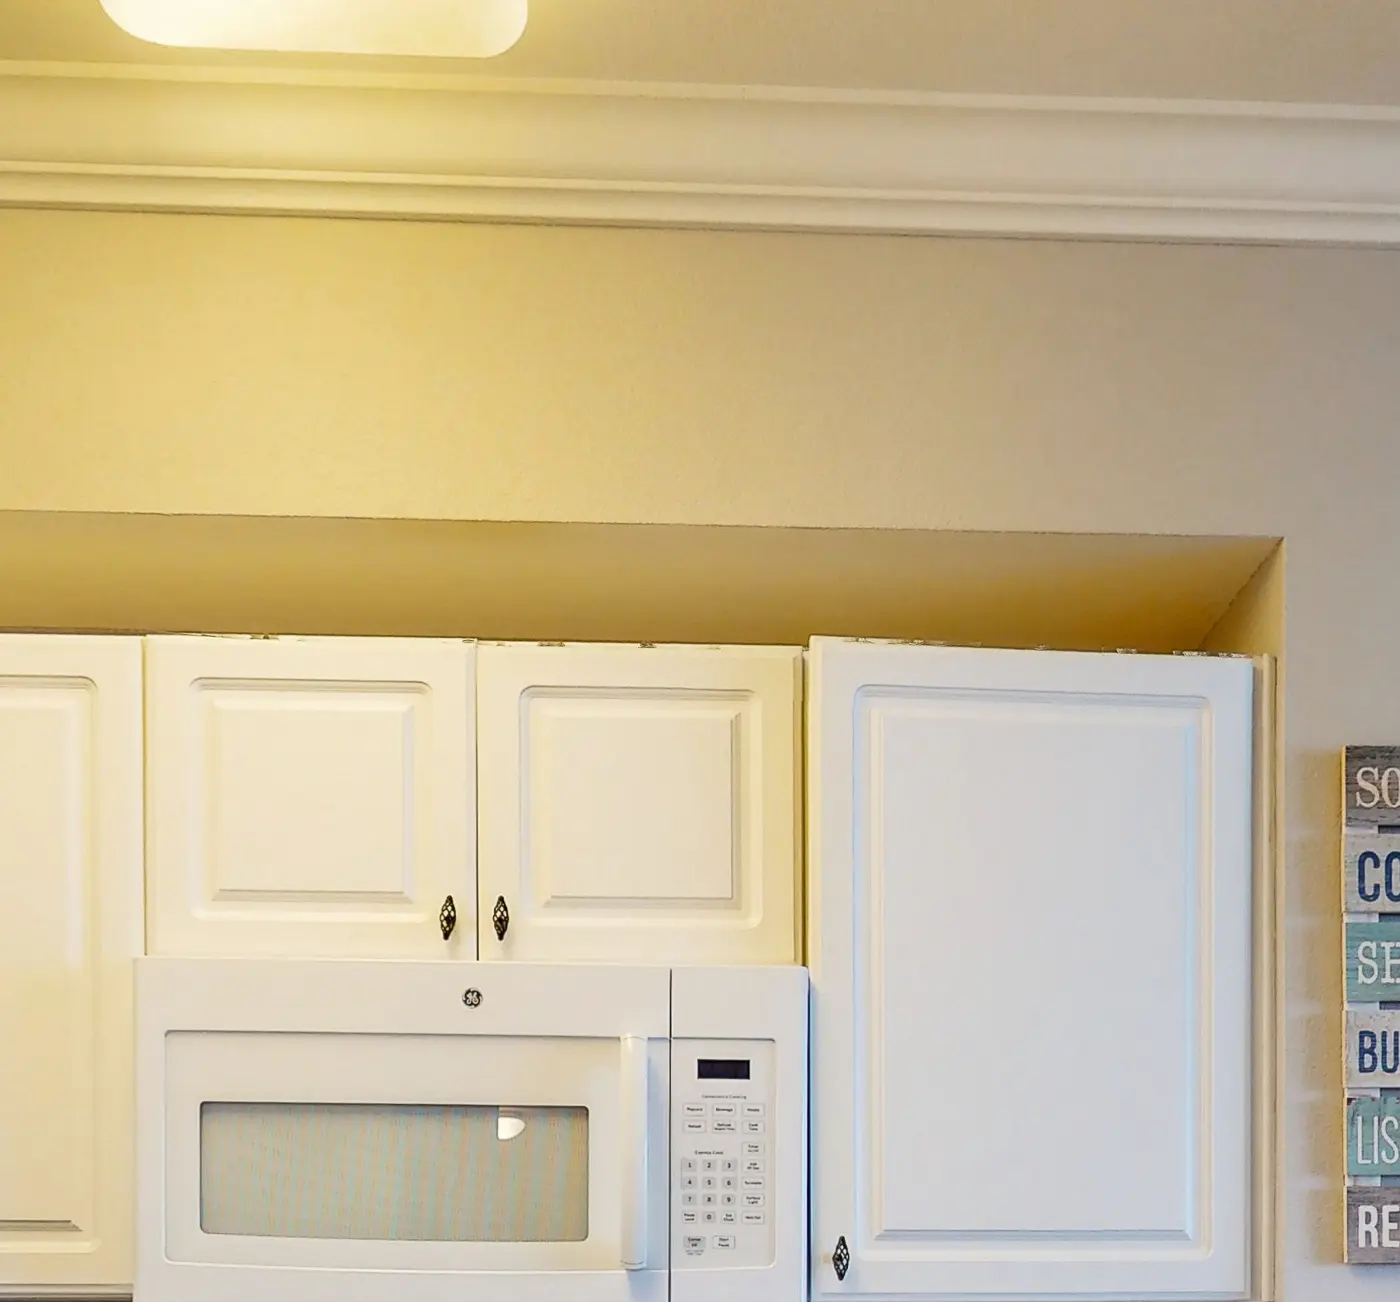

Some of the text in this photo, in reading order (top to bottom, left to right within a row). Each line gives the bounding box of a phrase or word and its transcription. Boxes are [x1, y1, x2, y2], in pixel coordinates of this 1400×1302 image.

[1358, 1030, 1399, 1073] BU
[1357, 1115, 1399, 1165] LIS
[1358, 1204, 1400, 1249] RE
